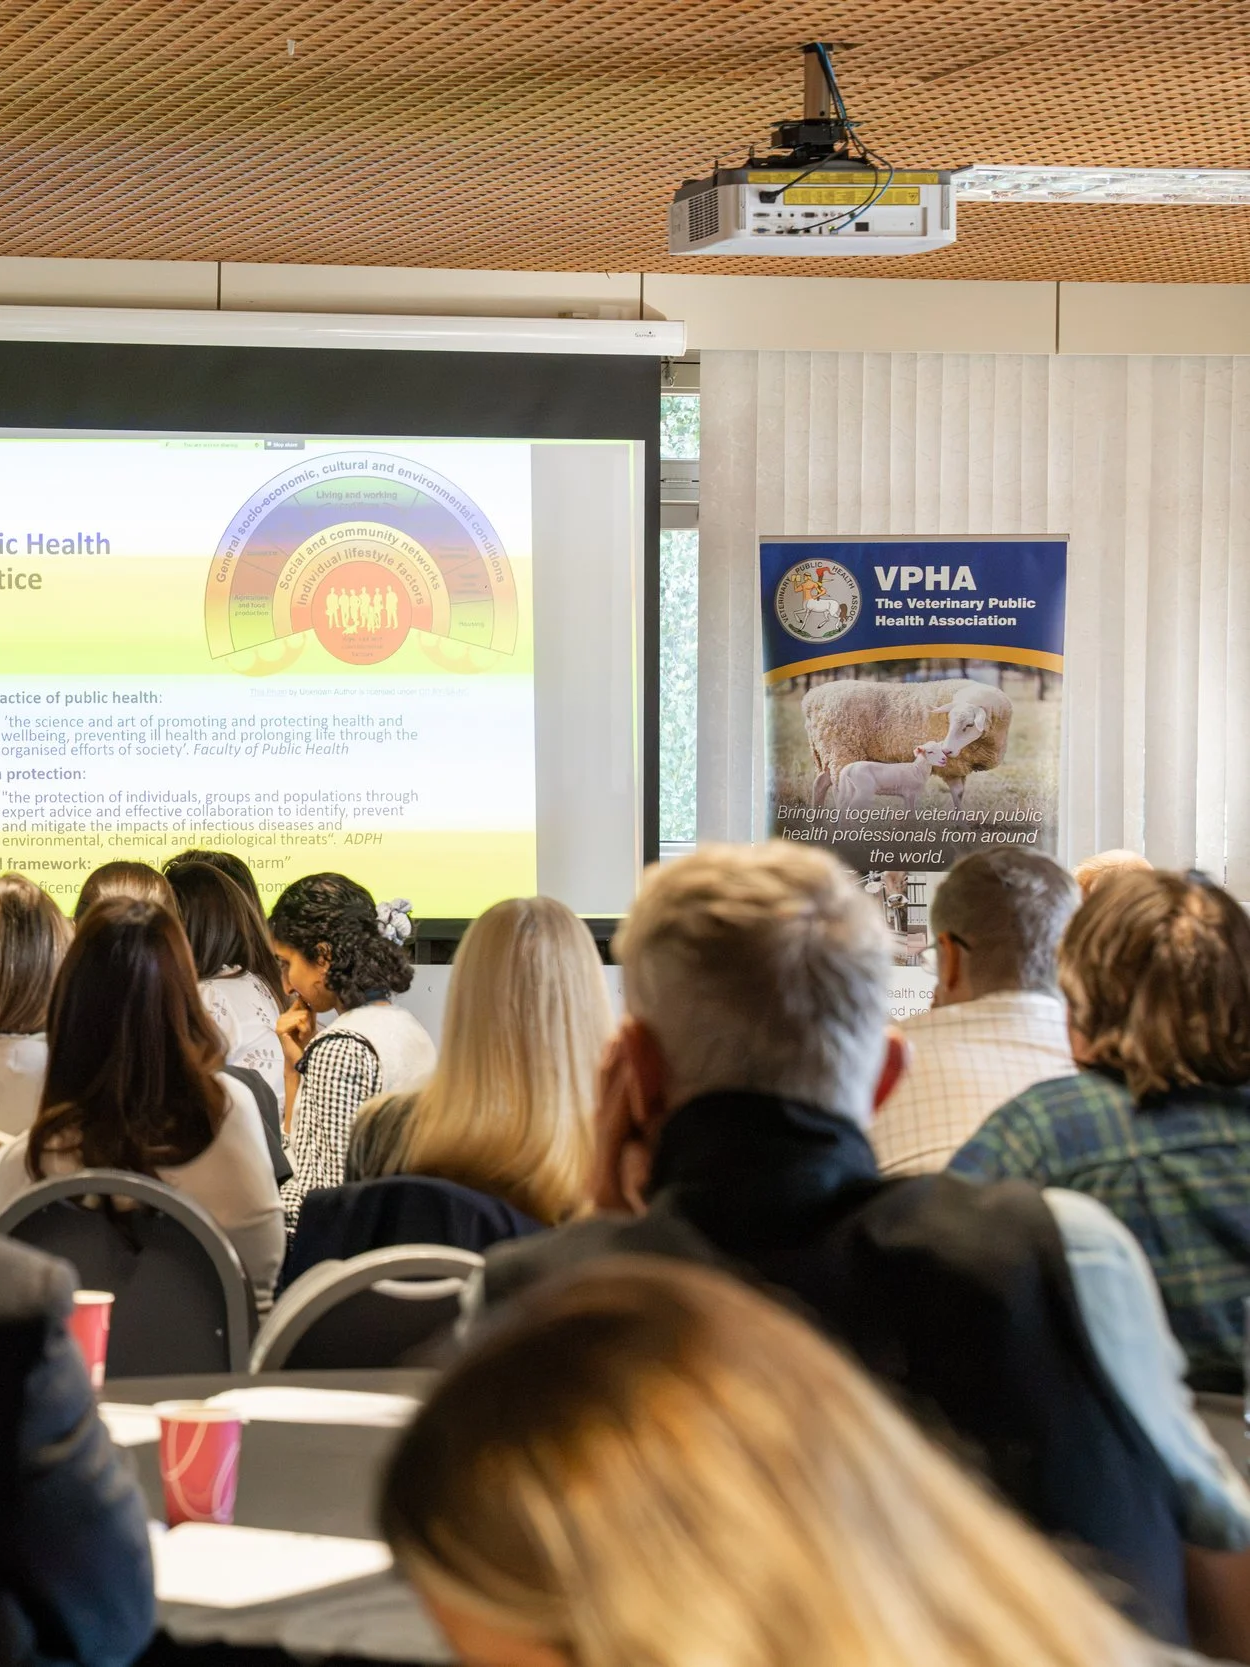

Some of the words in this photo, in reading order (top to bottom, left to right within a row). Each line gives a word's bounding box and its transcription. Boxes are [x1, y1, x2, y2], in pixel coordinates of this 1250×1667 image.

[316, 490, 343, 501] Living
[345, 490, 361, 499] and
[363, 490, 398, 501] working
[216, 535, 241, 583] General
[238, 469, 320, 535] socio-economic,
[322, 460, 368, 474] cultural
[372, 462, 395, 473] and
[398, 467, 475, 522] environmental
[472, 520, 504, 583] conditions
[27, 532, 110, 555] Health
[279, 554, 306, 590] Social
[306, 536, 327, 556] and
[330, 527, 399, 546] community
[400, 541, 440, 590] networks
[297, 552, 342, 606] Individual
[344, 548, 394, 566] lifestyle
[396, 563, 424, 605] factors
[874, 565, 977, 591] VPHA
[778, 576, 791, 623] VETERINARY
[795, 562, 823, 574] PUBLIC
[832, 566, 855, 589] HEALTH
[875, 598, 903, 609] The
[907, 598, 984, 611] Veterinary
[988, 597, 1037, 609] Public
[875, 615, 924, 626] Health
[929, 615, 1017, 626] Association
[46, 691, 60, 704] of
[65, 691, 108, 707] public
[112, 691, 162, 704] health:
[35, 716, 84, 728] science
[88, 715, 113, 728] and
[117, 717, 136, 728] art
[140, 715, 155, 728] of
[157, 715, 227, 729] promoting
[231, 715, 256, 727] and
[260, 715, 328, 730] protecting
[333, 715, 374, 727] health
[379, 715, 403, 727] and
[1, 729, 70, 744] wellbeing,
[75, 730, 146, 744] preventing
[150, 729, 161, 742] ill
[166, 729, 207, 741] health
[211, 729, 236, 741] and
[240, 729, 311, 743] prolonging
[316, 728, 336, 741] life
[340, 728, 392, 743] through
[396, 728, 418, 740] the
[1, 744, 66, 758] organised
[70, 743, 114, 755] efforts
[118, 743, 133, 755] of
[194, 743, 241, 757] Faculty
[245, 742, 259, 757] of
[262, 743, 301, 755] Public
[305, 742, 349, 755] Health
[7, 768, 86, 783] protection:
[35, 791, 105, 805] protection
[109, 791, 123, 803] of
[126, 790, 201, 804] individuals,
[205, 792, 250, 805] groups
[255, 790, 279, 802] and
[284, 790, 362, 805] populations
[366, 790, 418, 804] through
[2, 806, 45, 820] expert
[49, 805, 92, 817] advice
[96, 805, 121, 817] and
[125, 805, 182, 817] effective
[186, 805, 273, 817] collaboration
[278, 806, 292, 817] to
[296, 804, 349, 819] identify,
[354, 805, 404, 818] prevent
[777, 805, 840, 823] Bringing
[845, 806, 910, 823] together
[914, 806, 989, 825] veterinary
[992, 807, 1043, 823] public
[2, 820, 26, 832] and
[31, 820, 86, 834] mitigate
[90, 820, 112, 832] the
[116, 820, 168, 834] impacts
[172, 819, 187, 831] of
[190, 819, 254, 831] infectious
[259, 819, 313, 831] diseases
[318, 818, 343, 831] and
[2, 834, 103, 847] environmental,
[108, 834, 167, 846] chemical
[171, 833, 196, 846] and
[200, 833, 276, 848] radiological
[344, 833, 383, 845] ADPH
[782, 827, 828, 841] health
[832, 827, 937, 844] professionals
[941, 828, 976, 842] from
[980, 829, 1038, 844] around
[7, 857, 91, 870] framework:
[869, 848, 895, 862] the
[899, 849, 945, 863] world.
[886, 988, 915, 999] ealth
